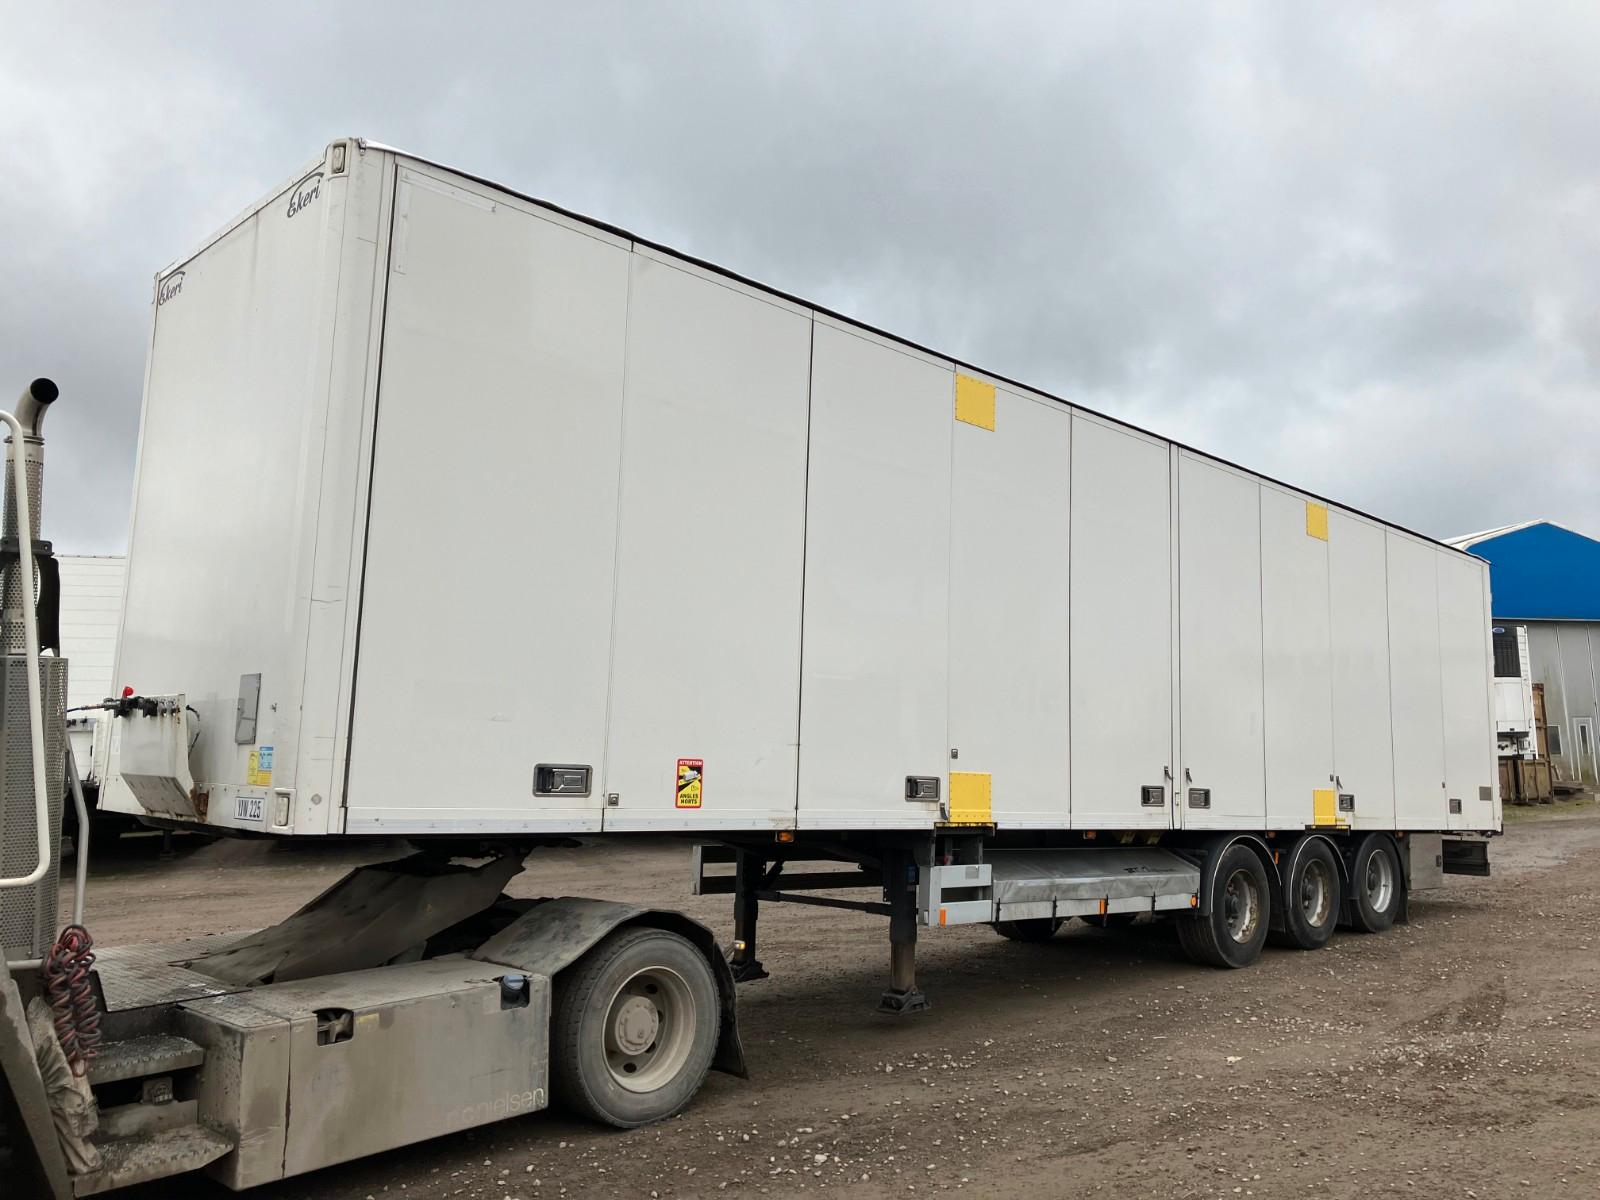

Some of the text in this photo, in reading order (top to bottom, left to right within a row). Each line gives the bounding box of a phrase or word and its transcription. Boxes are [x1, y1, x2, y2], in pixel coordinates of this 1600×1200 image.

[287, 172, 324, 217] Ekeri
[159, 271, 185, 305] Ekeri
[249, 800, 261, 818] 225
